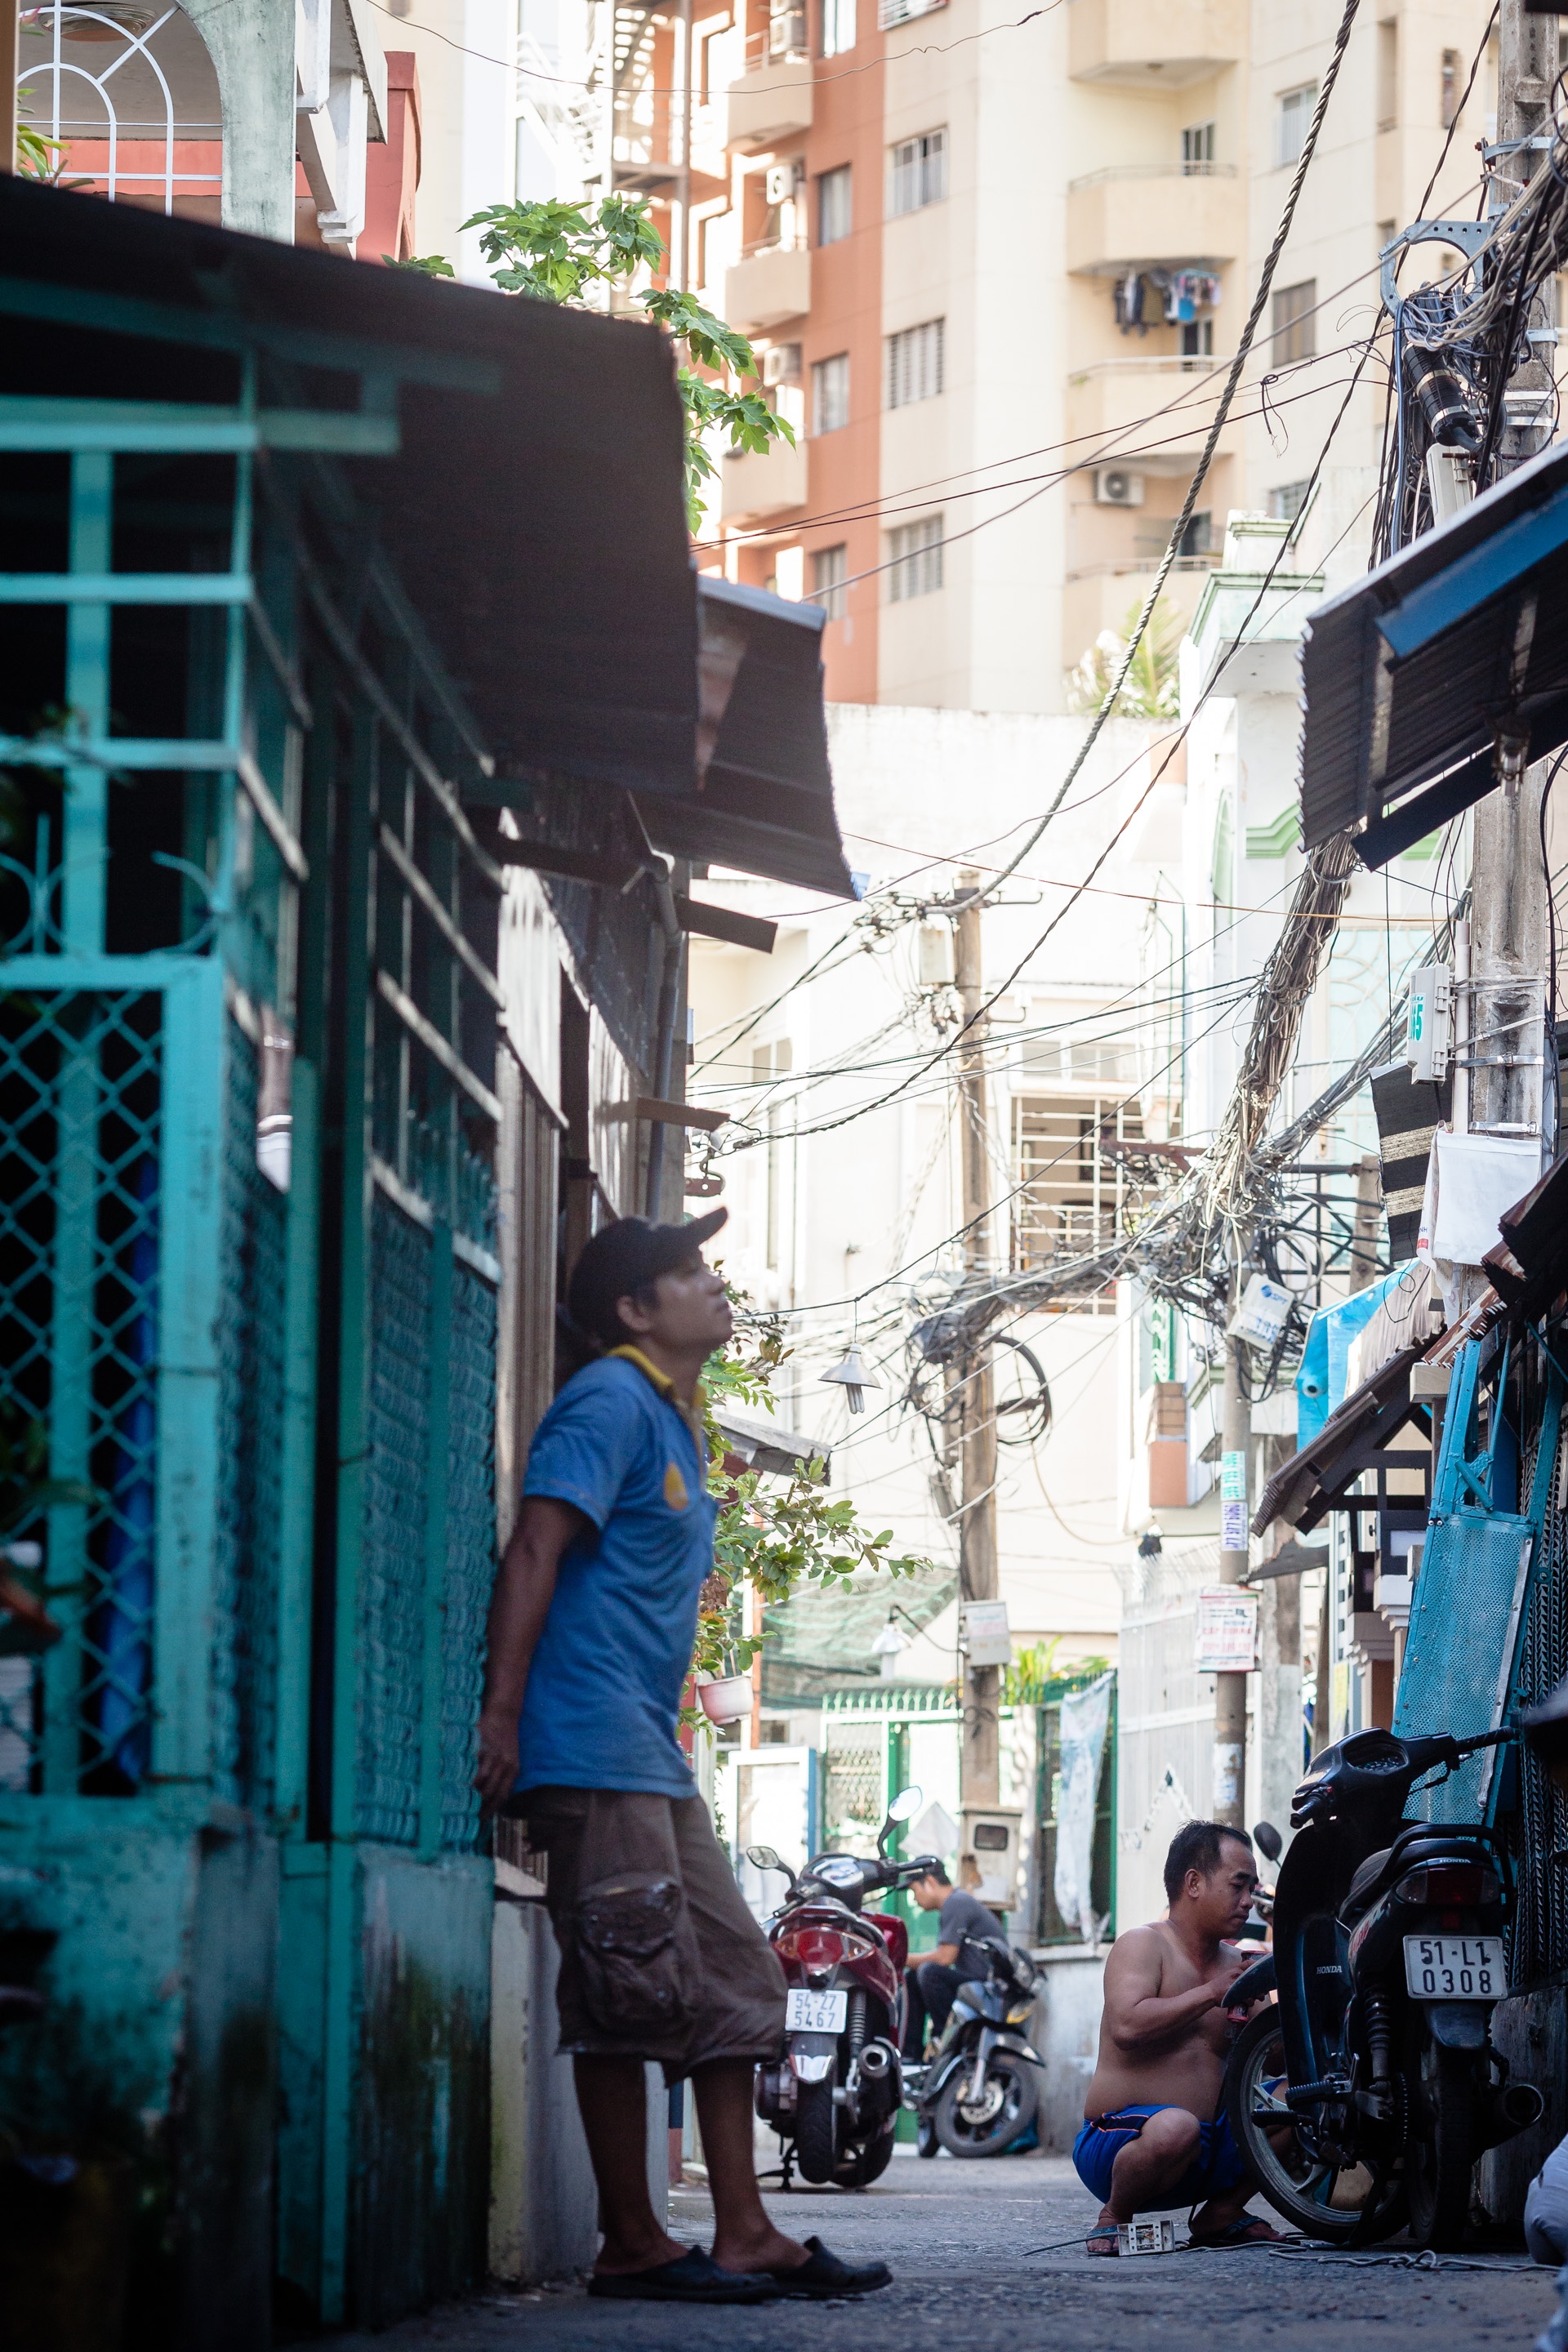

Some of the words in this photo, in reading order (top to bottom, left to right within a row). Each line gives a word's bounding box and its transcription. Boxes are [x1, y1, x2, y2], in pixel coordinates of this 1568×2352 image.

[1316, 1965, 1343, 1975] HONDA
[1422, 1969, 1492, 1994] 0308
[794, 2011, 835, 2028] 5467
